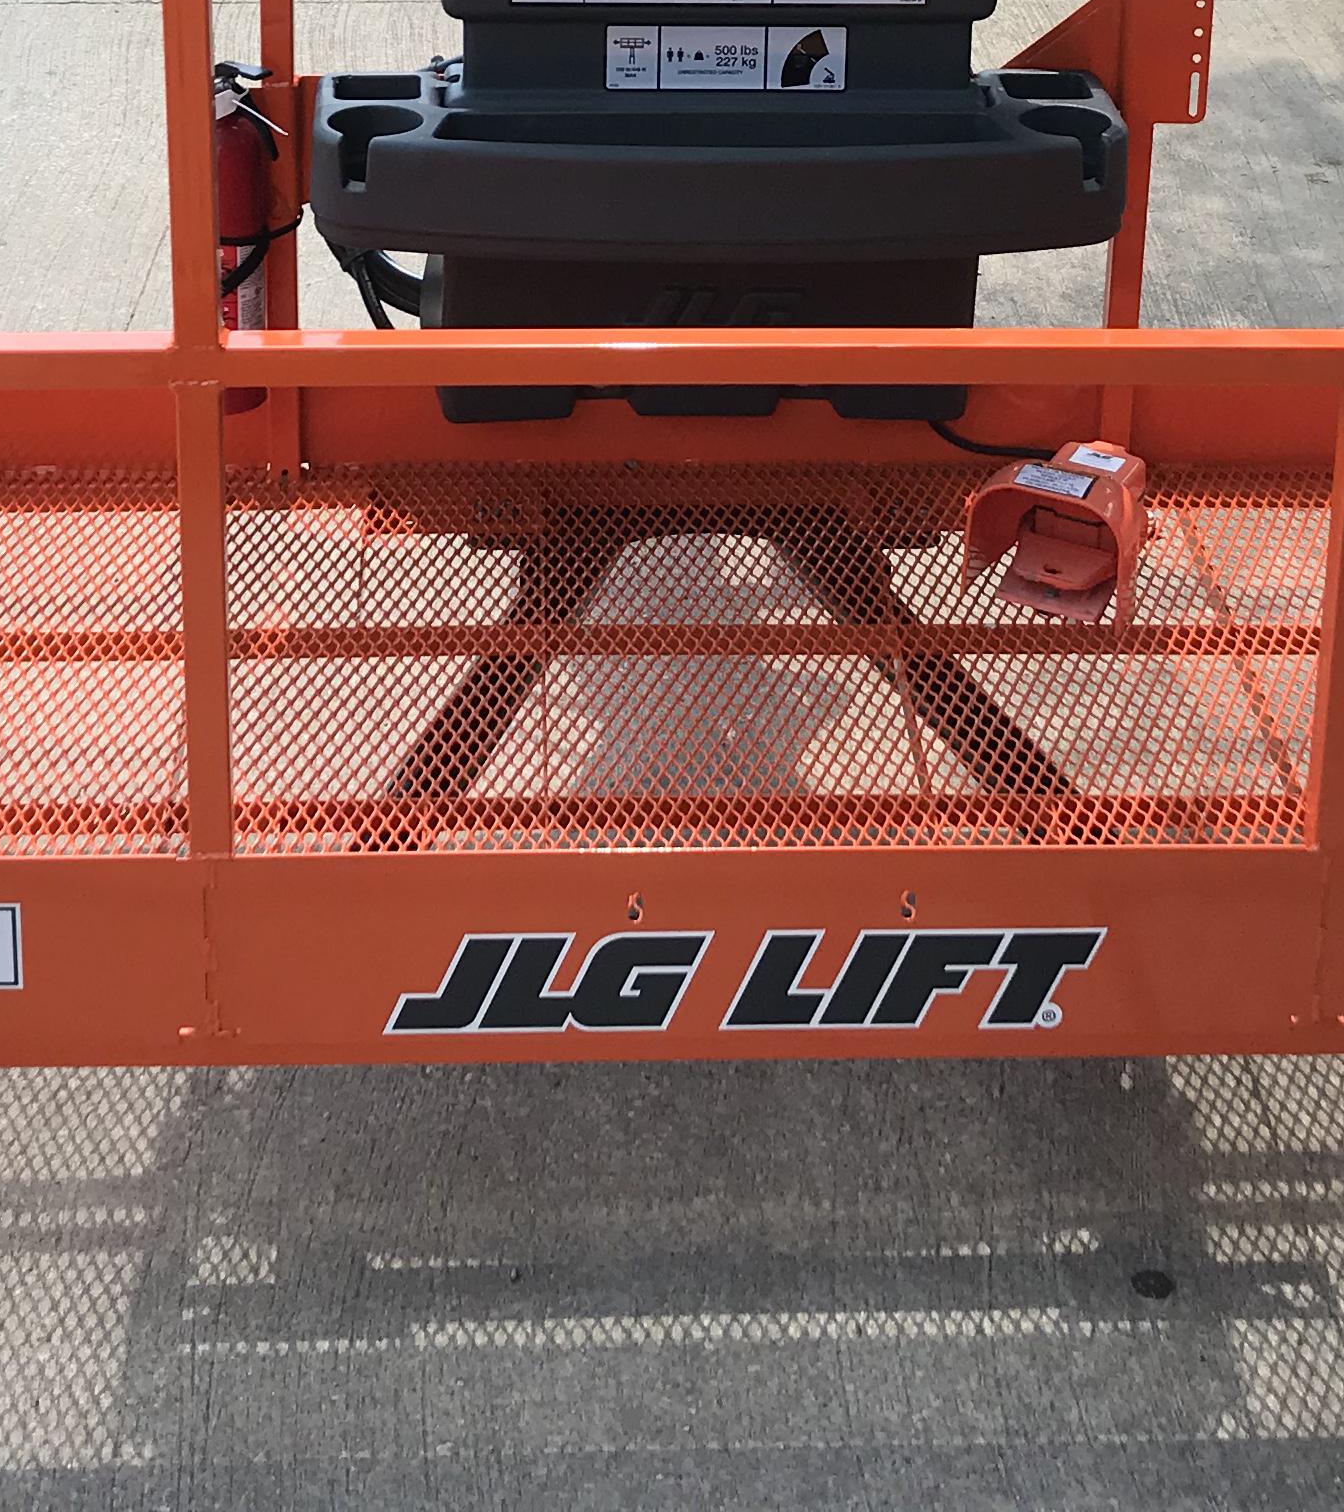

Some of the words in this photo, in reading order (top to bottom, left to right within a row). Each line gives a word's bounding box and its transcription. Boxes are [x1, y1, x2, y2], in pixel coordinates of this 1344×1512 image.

[714, 45, 738, 56] 500
[740, 45, 759, 56] lbs
[716, 56, 738, 67] 227
[741, 56, 757, 69] kg
[384, 931, 714, 1033] JLG
[720, 928, 1107, 1030] LIFT
